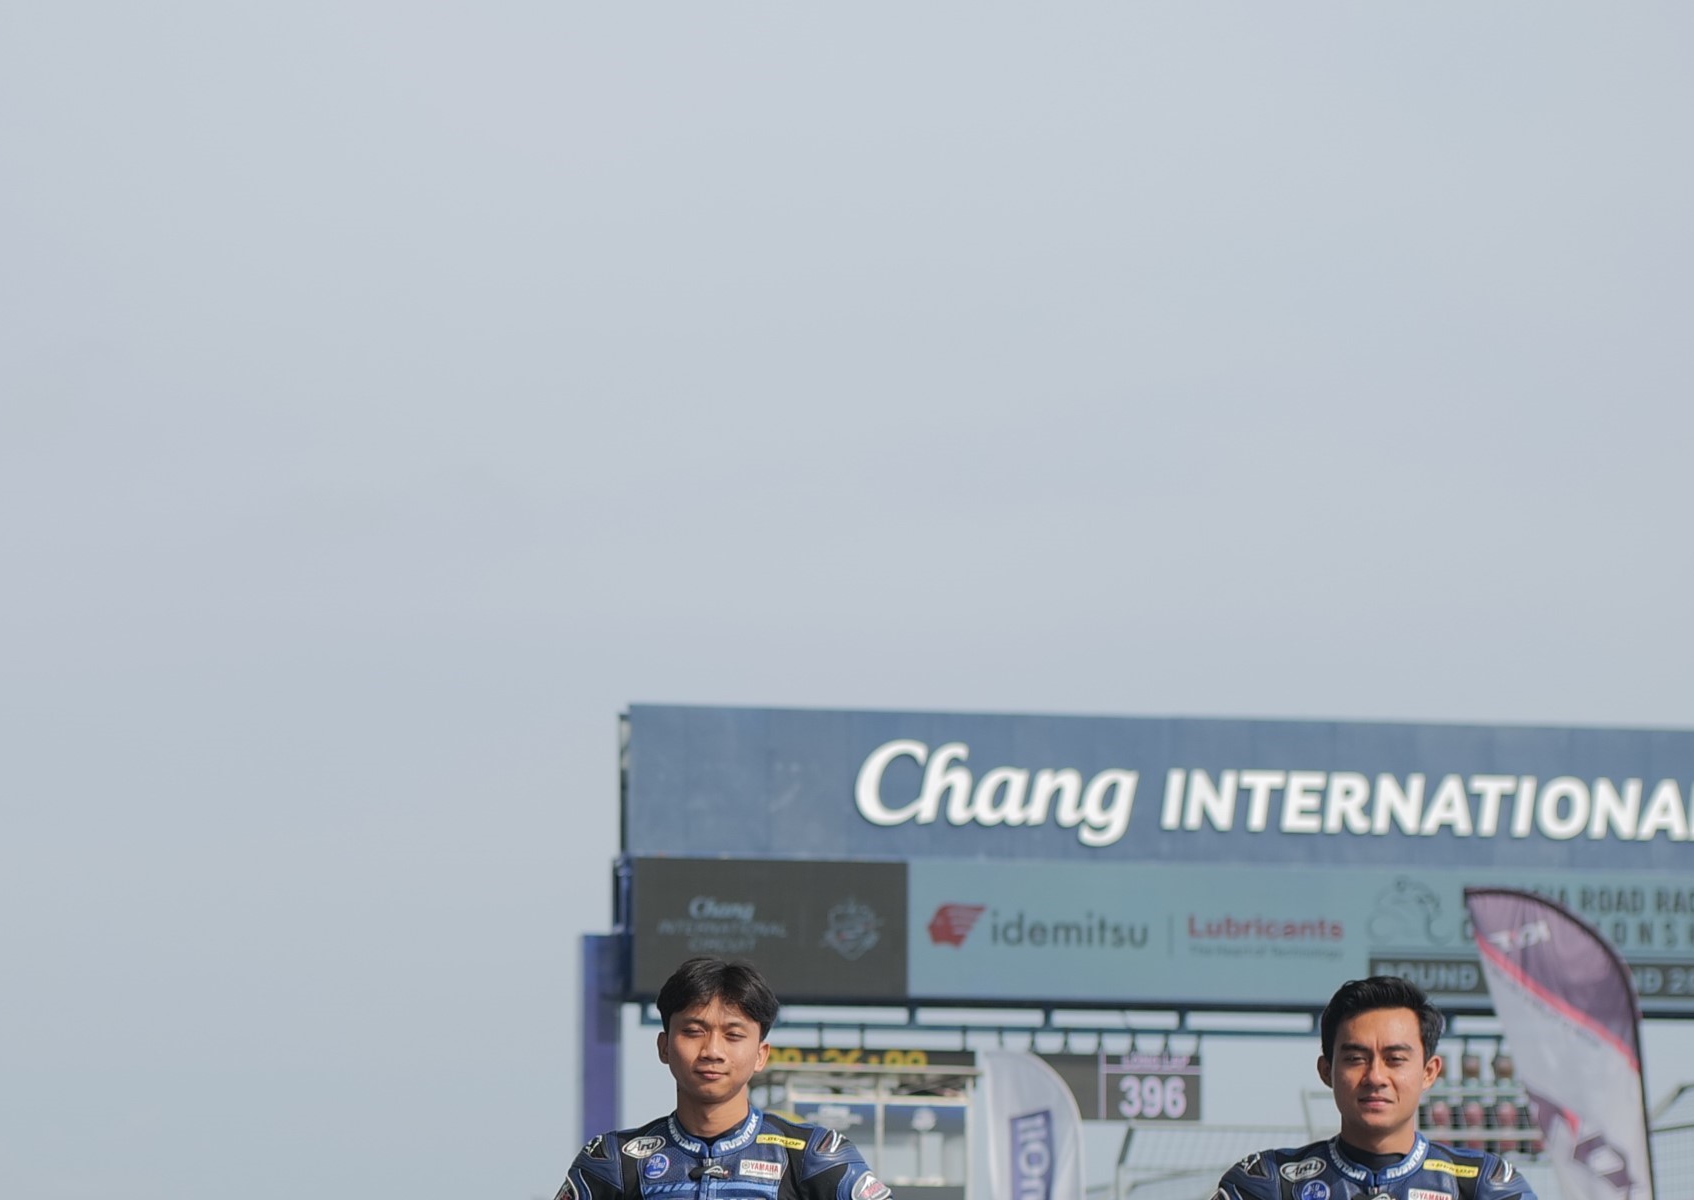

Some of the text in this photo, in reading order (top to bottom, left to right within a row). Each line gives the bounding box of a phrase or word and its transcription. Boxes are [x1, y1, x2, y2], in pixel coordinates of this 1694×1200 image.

[854, 739, 1694, 847] Chang INTERNATIONA
[688, 897, 755, 924] Chang
[1581, 887, 1644, 914] ROAD
[991, 908, 1149, 949] idemitsu
[1187, 914, 1343, 941] Lubricants
[1119, 1076, 1187, 1119] 396
[631, 1137, 659, 1152] Arai
[766, 1135, 803, 1147] DUNLOP
[750, 1161, 780, 1175] YAMAHA
[1290, 1158, 1320, 1177] Arai
